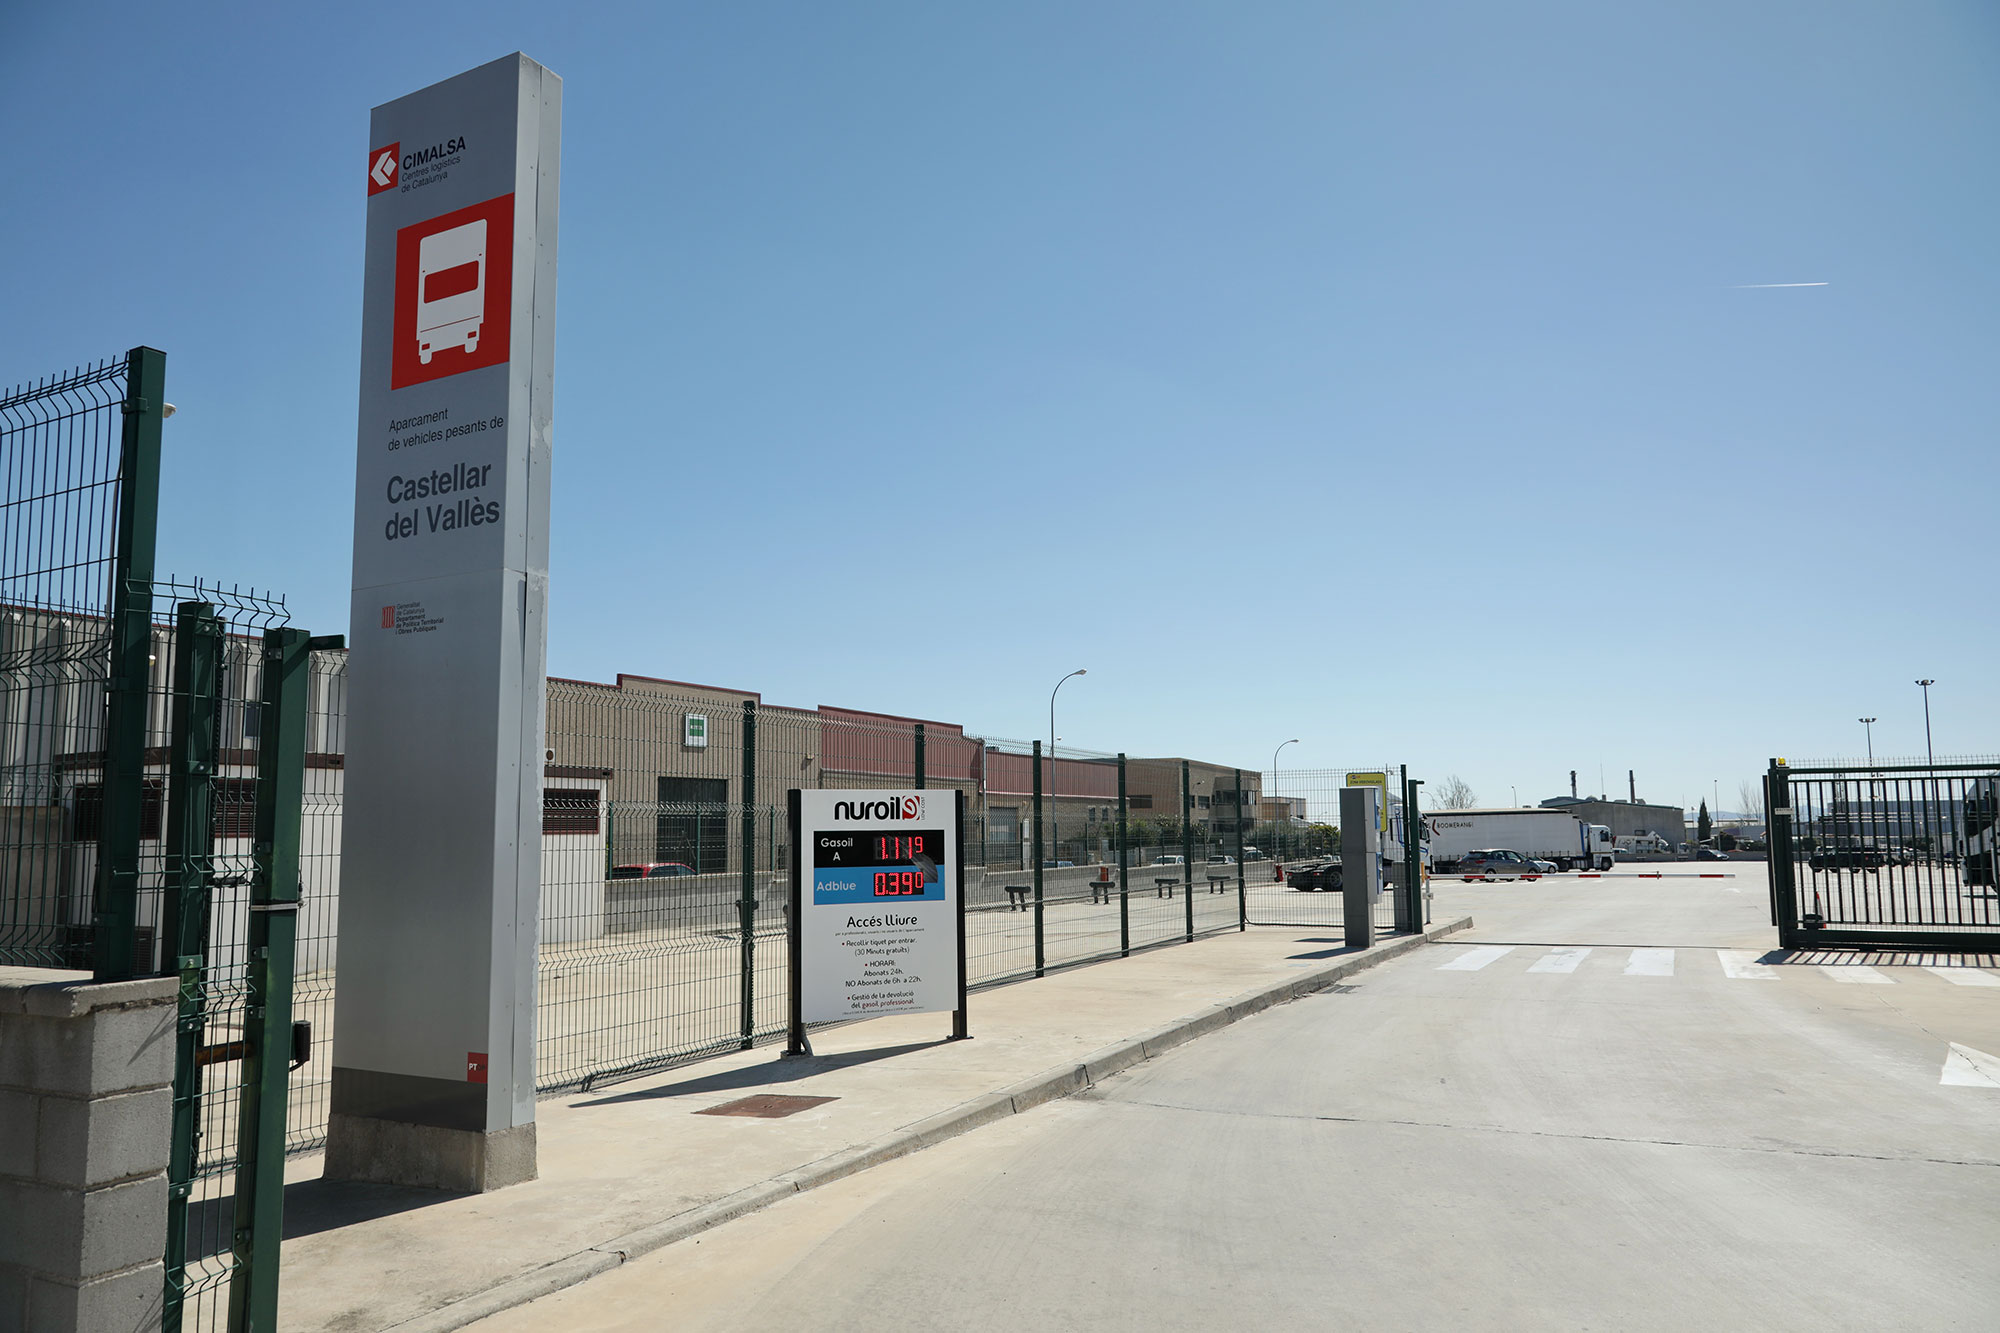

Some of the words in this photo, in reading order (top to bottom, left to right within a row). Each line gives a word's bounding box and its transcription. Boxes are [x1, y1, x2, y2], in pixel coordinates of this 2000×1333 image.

[403, 136, 466, 170] CIMALSA
[401, 184, 411, 193] de
[412, 171, 448, 189] Catalunya
[402, 167, 429, 182] Centres
[389, 408, 448, 434] Aparcament
[388, 438, 400, 451] de
[403, 430, 443, 447] vehicles
[446, 420, 487, 441] pesants
[490, 416, 504, 429] de
[387, 462, 491, 504] Castellar
[385, 508, 418, 540] del
[426, 496, 500, 533] Vallès
[834, 797, 900, 820] nuroil
[820, 838, 853, 847] Gasoil
[833, 852, 841, 861] A
[816, 881, 856, 891] Adblue
[846, 914, 882, 928] Accés
[885, 914, 918, 927] lliure
[870, 939, 886, 947] tiquet
[855, 949, 865, 957] (30
[862, 1001, 879, 1010] gasoil
[880, 998, 914, 1008] professional
